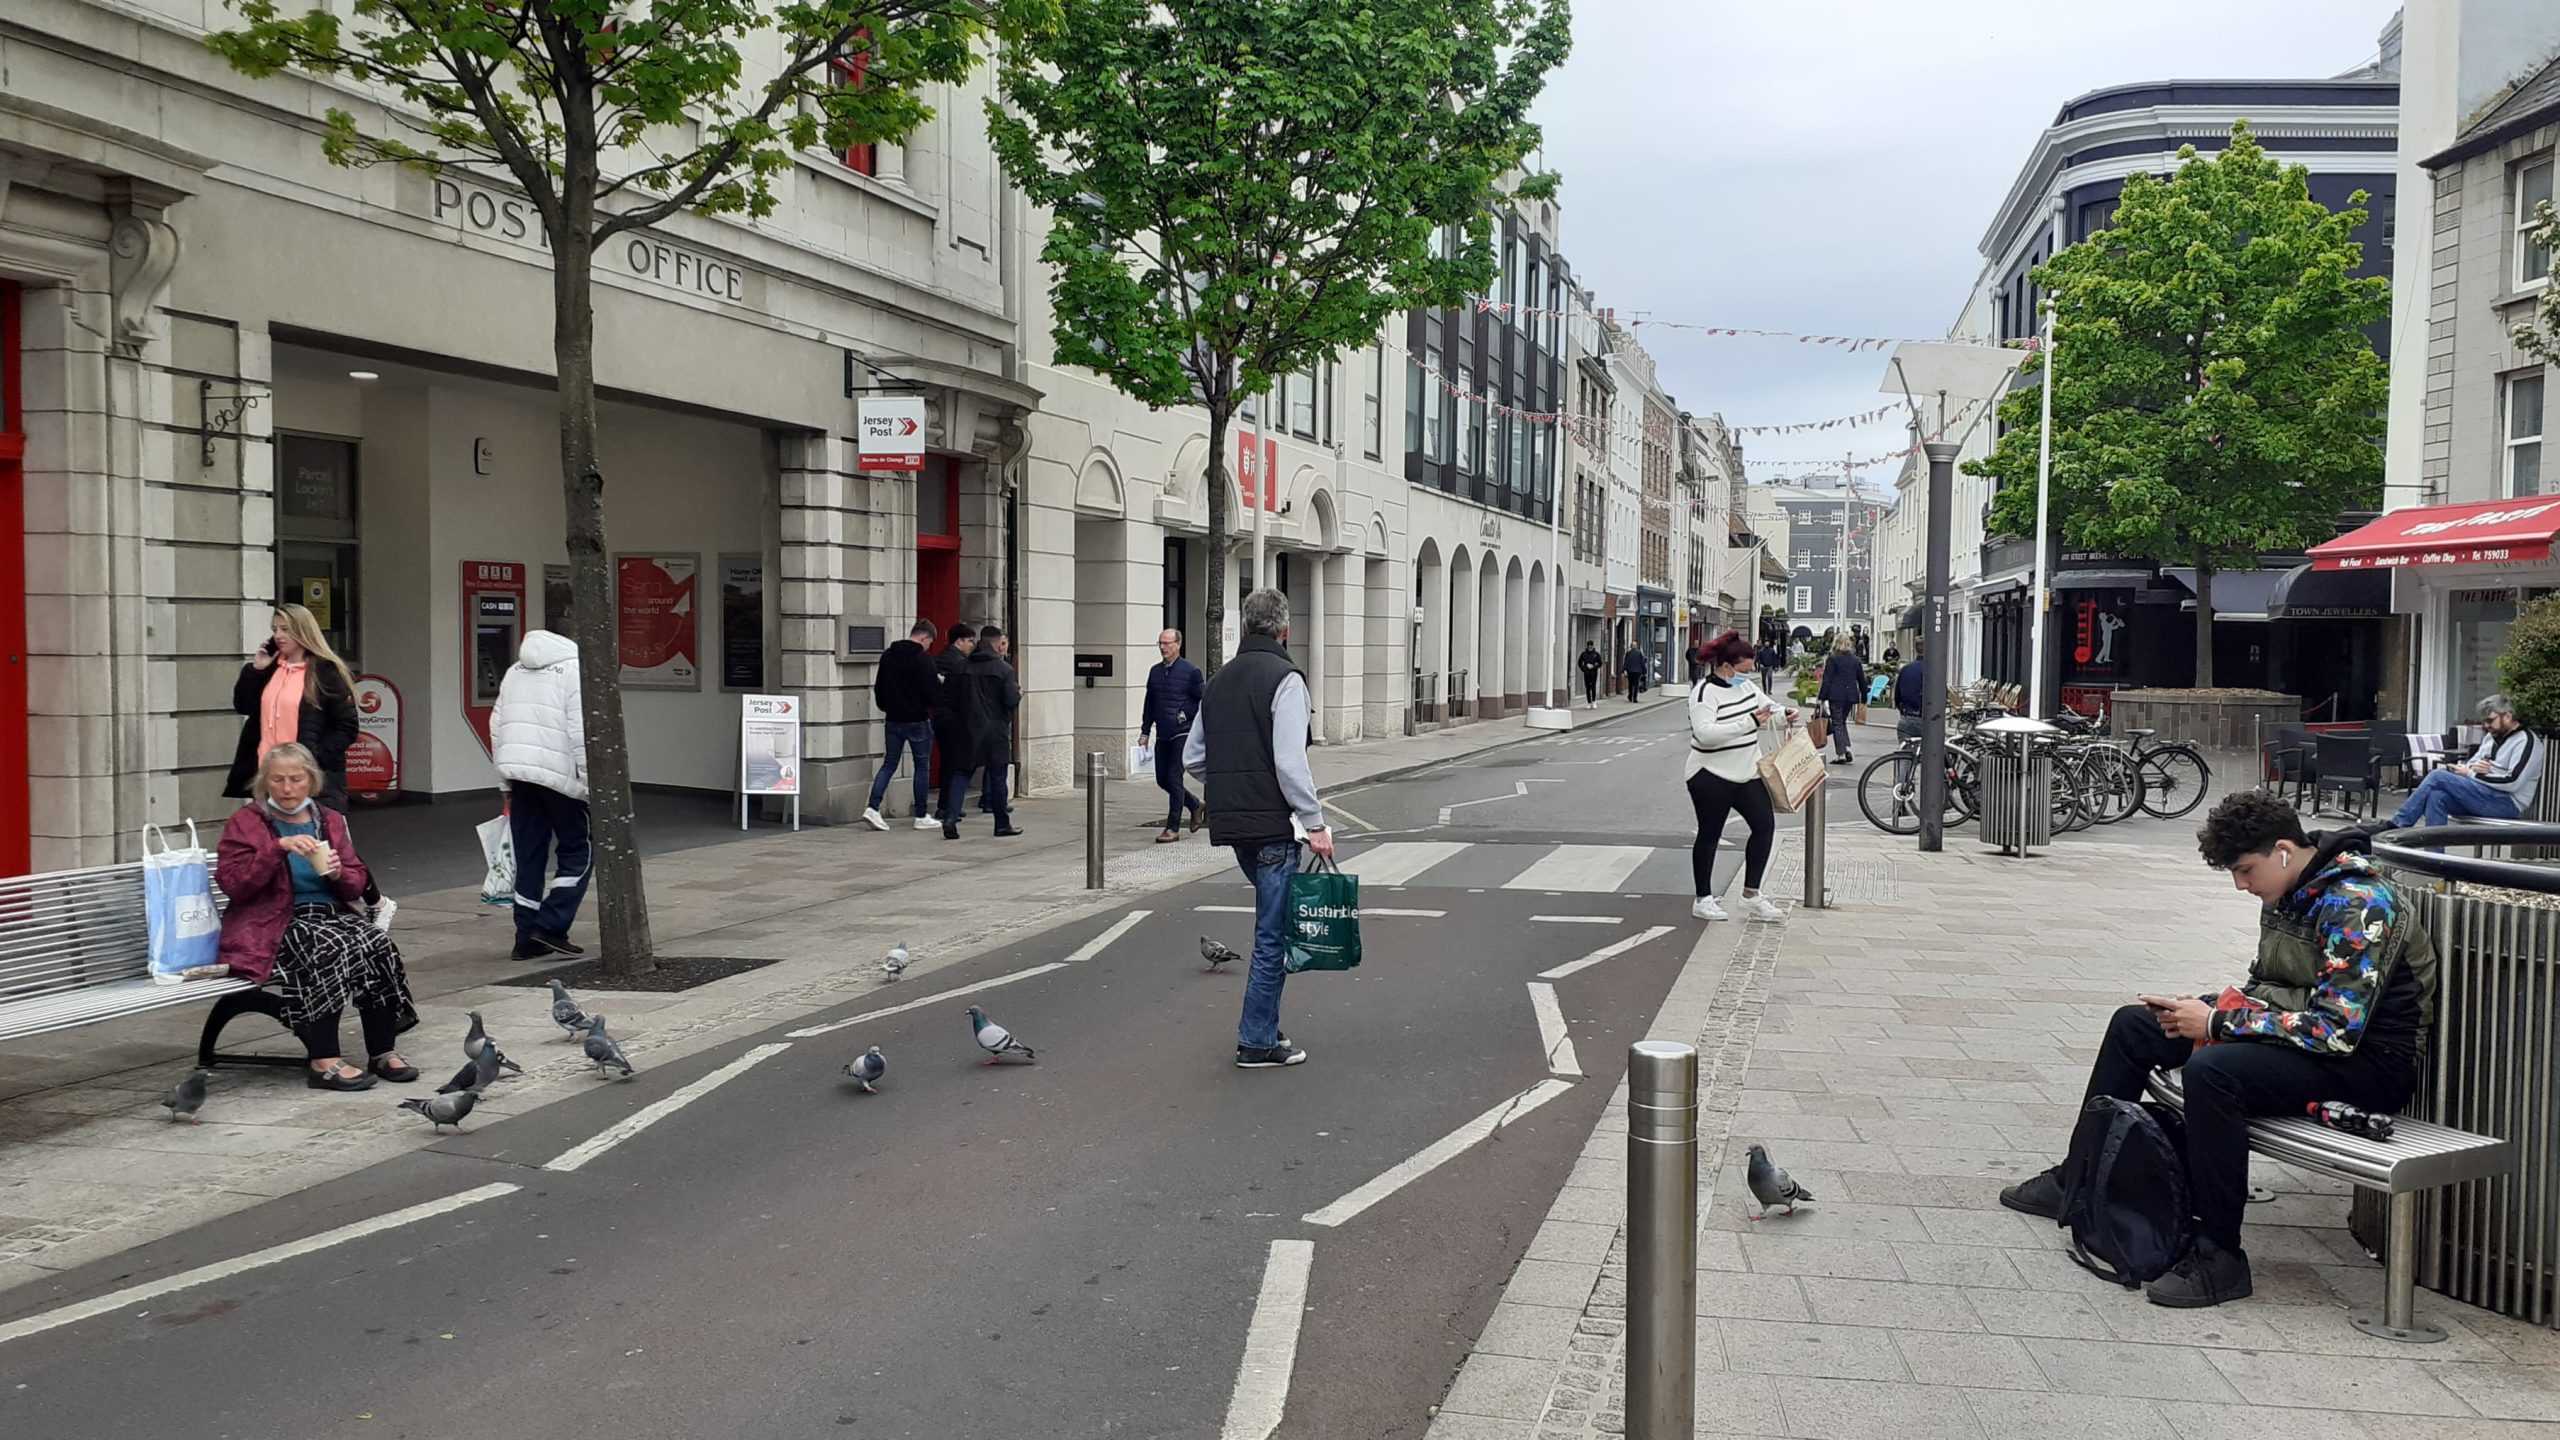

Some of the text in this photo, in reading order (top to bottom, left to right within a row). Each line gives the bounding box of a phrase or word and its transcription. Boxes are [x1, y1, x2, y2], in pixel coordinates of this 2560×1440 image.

[433, 179, 743, 302] POST OFFICE
[863, 416, 893, 426] Jersey
[870, 427, 892, 437] Post
[2350, 558, 2362, 567] Food
[2422, 553, 2441, 563] Coffee
[2442, 552, 2456, 564] Shop
[2483, 549, 2510, 560] 759033
[2460, 590, 2507, 602] THE TASTE
[481, 602, 498, 610] CASH
[624, 605, 660, 614] the world
[2290, 607, 2378, 616] TOWN JEWELLERS
[749, 699, 773, 707] Jersey
[754, 706, 772, 714] Post
[357, 716, 394, 725] neyGram
[345, 765, 385, 773] worldwide
[1299, 921, 1330, 937] style
